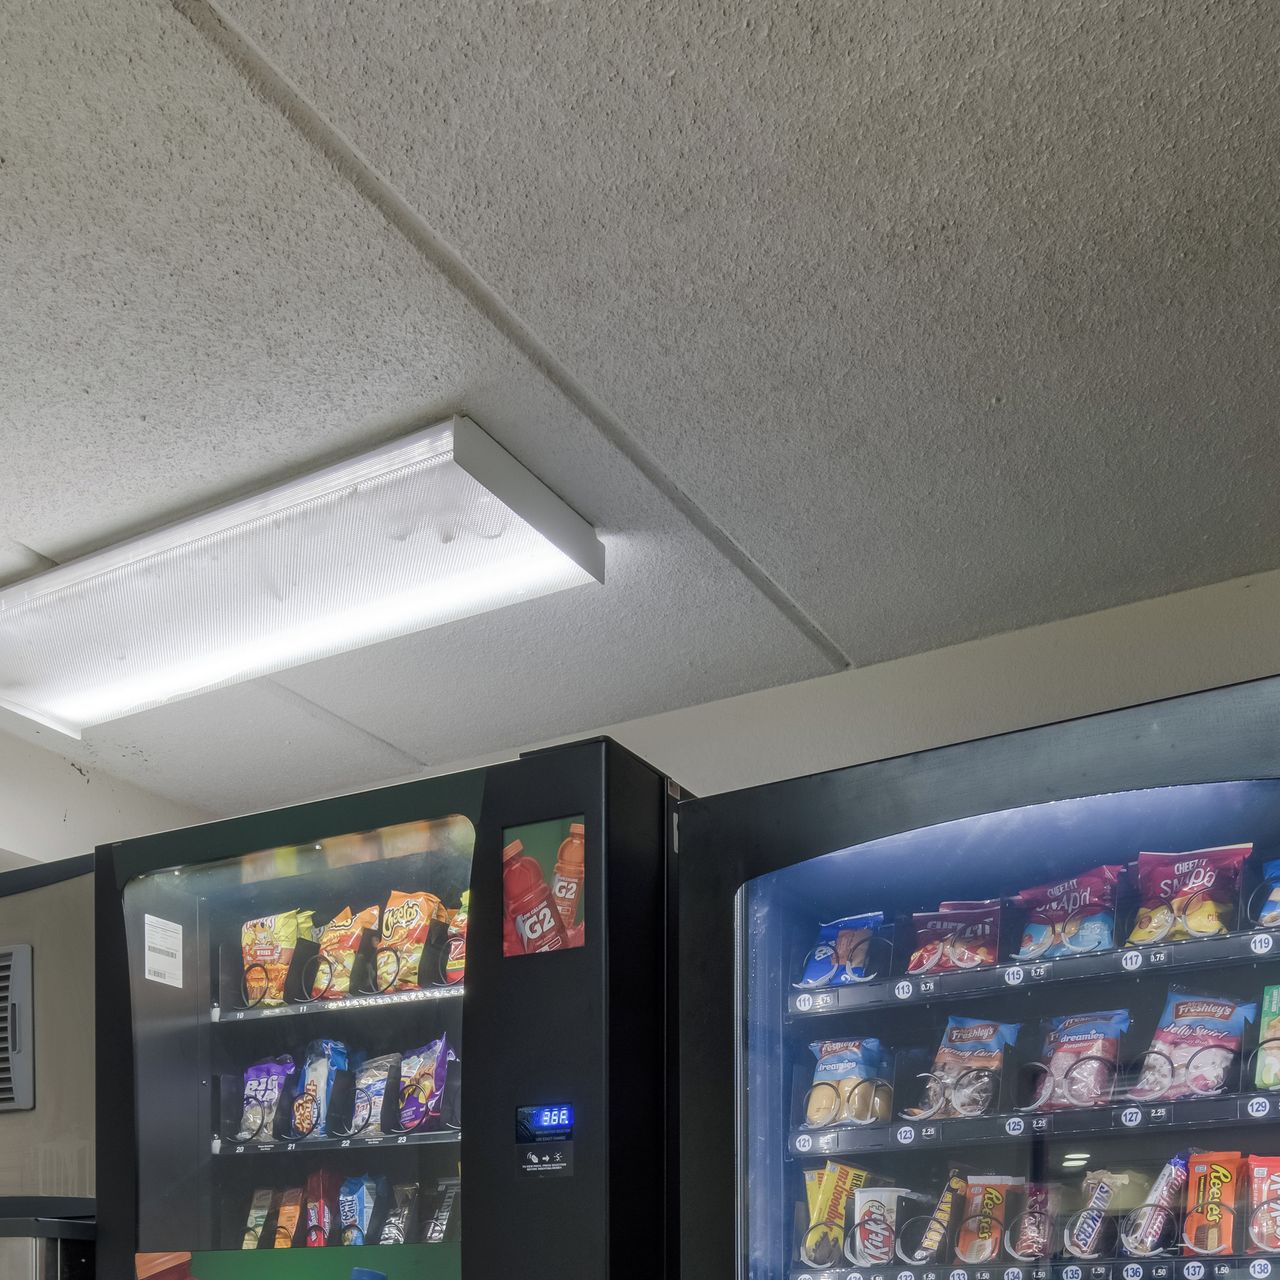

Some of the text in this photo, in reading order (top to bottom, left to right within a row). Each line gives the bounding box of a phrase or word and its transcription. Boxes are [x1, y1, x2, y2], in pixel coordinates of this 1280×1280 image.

[555, 881, 577, 899] G2
[382, 897, 421, 941] Cheetos
[525, 908, 555, 939] G2
[1251, 937, 1270, 950] 119
[1123, 954, 1140, 967] 117
[1005, 970, 1021, 982] 115
[896, 984, 911, 995] 113
[797, 997, 811, 1008] 111
[1178, 1003, 1232, 1018] Freshley's
[952, 1026, 994, 1040] Freshley's
[1060, 1029, 1105, 1043] dreamies
[1163, 1023, 1230, 1039] Jelly Swirl
[1151, 1108, 1166, 1117] 2.25
[1249, 1101, 1267, 1113] 129
[1122, 1110, 1140, 1123] 127
[1006, 1120, 1023, 1132] 125
[1032, 1119, 1046, 1128] 2.25
[398, 1136, 407, 1144] 23
[897, 1129, 914, 1141] 123
[341, 1139, 351, 1147] 22
[796, 1137, 811, 1148] 121
[1206, 1163, 1232, 1224] Reese's
[978, 1186, 1004, 1241] Reese's
[1075, 1183, 1112, 1248] SNICKERS
[1063, 1269, 1081, 1280] 135
[1091, 1266, 1106, 1275] 1.50
[1123, 1267, 1141, 1278] 136
[1151, 1268, 1167, 1277] 1.50
[1184, 1265, 1203, 1276] 137
[1214, 1266, 1230, 1275] 1.50
[1250, 1263, 1269, 1275] 138
